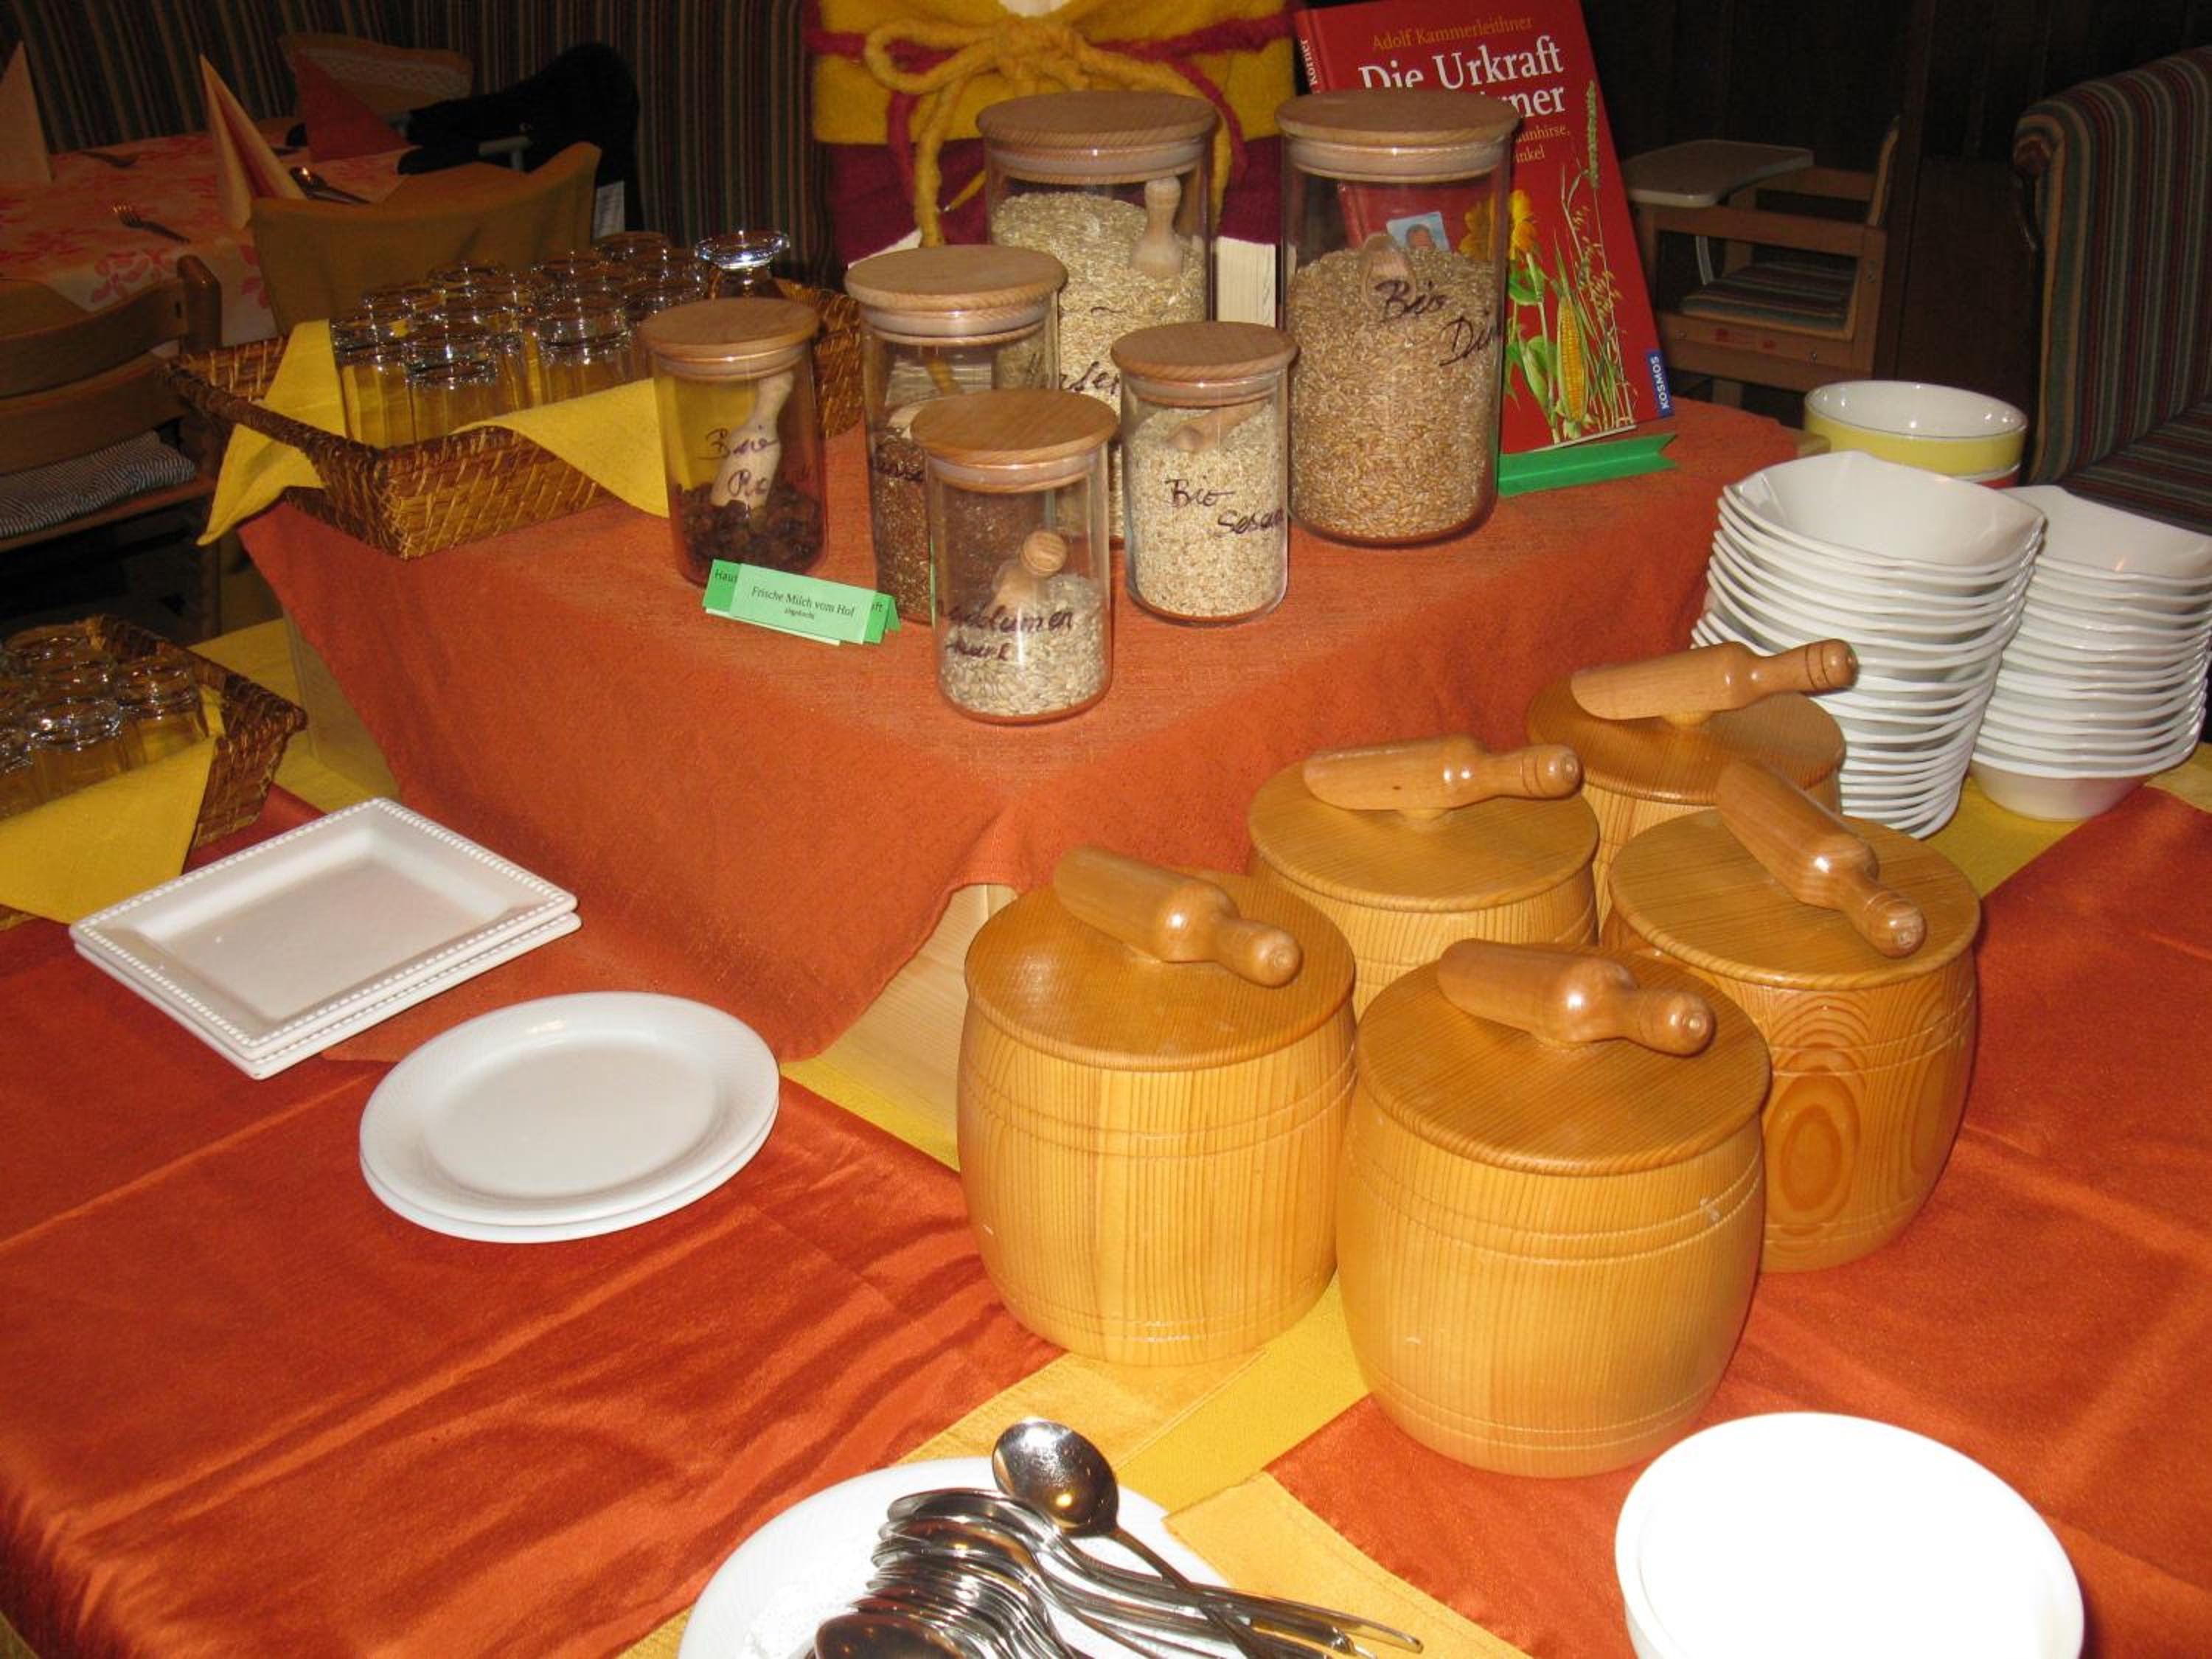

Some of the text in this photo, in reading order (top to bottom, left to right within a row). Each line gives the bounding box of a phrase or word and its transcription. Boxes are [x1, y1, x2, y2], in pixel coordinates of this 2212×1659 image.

[1373, 15, 1533, 51] Adolf Kammerleithner
[1357, 35, 1564, 89] Die Urkraft
[1649, 356, 1670, 410] KOSMOS
[1164, 475, 1236, 508] Bio
[751, 586, 855, 618] Frische Milch vom Hof
